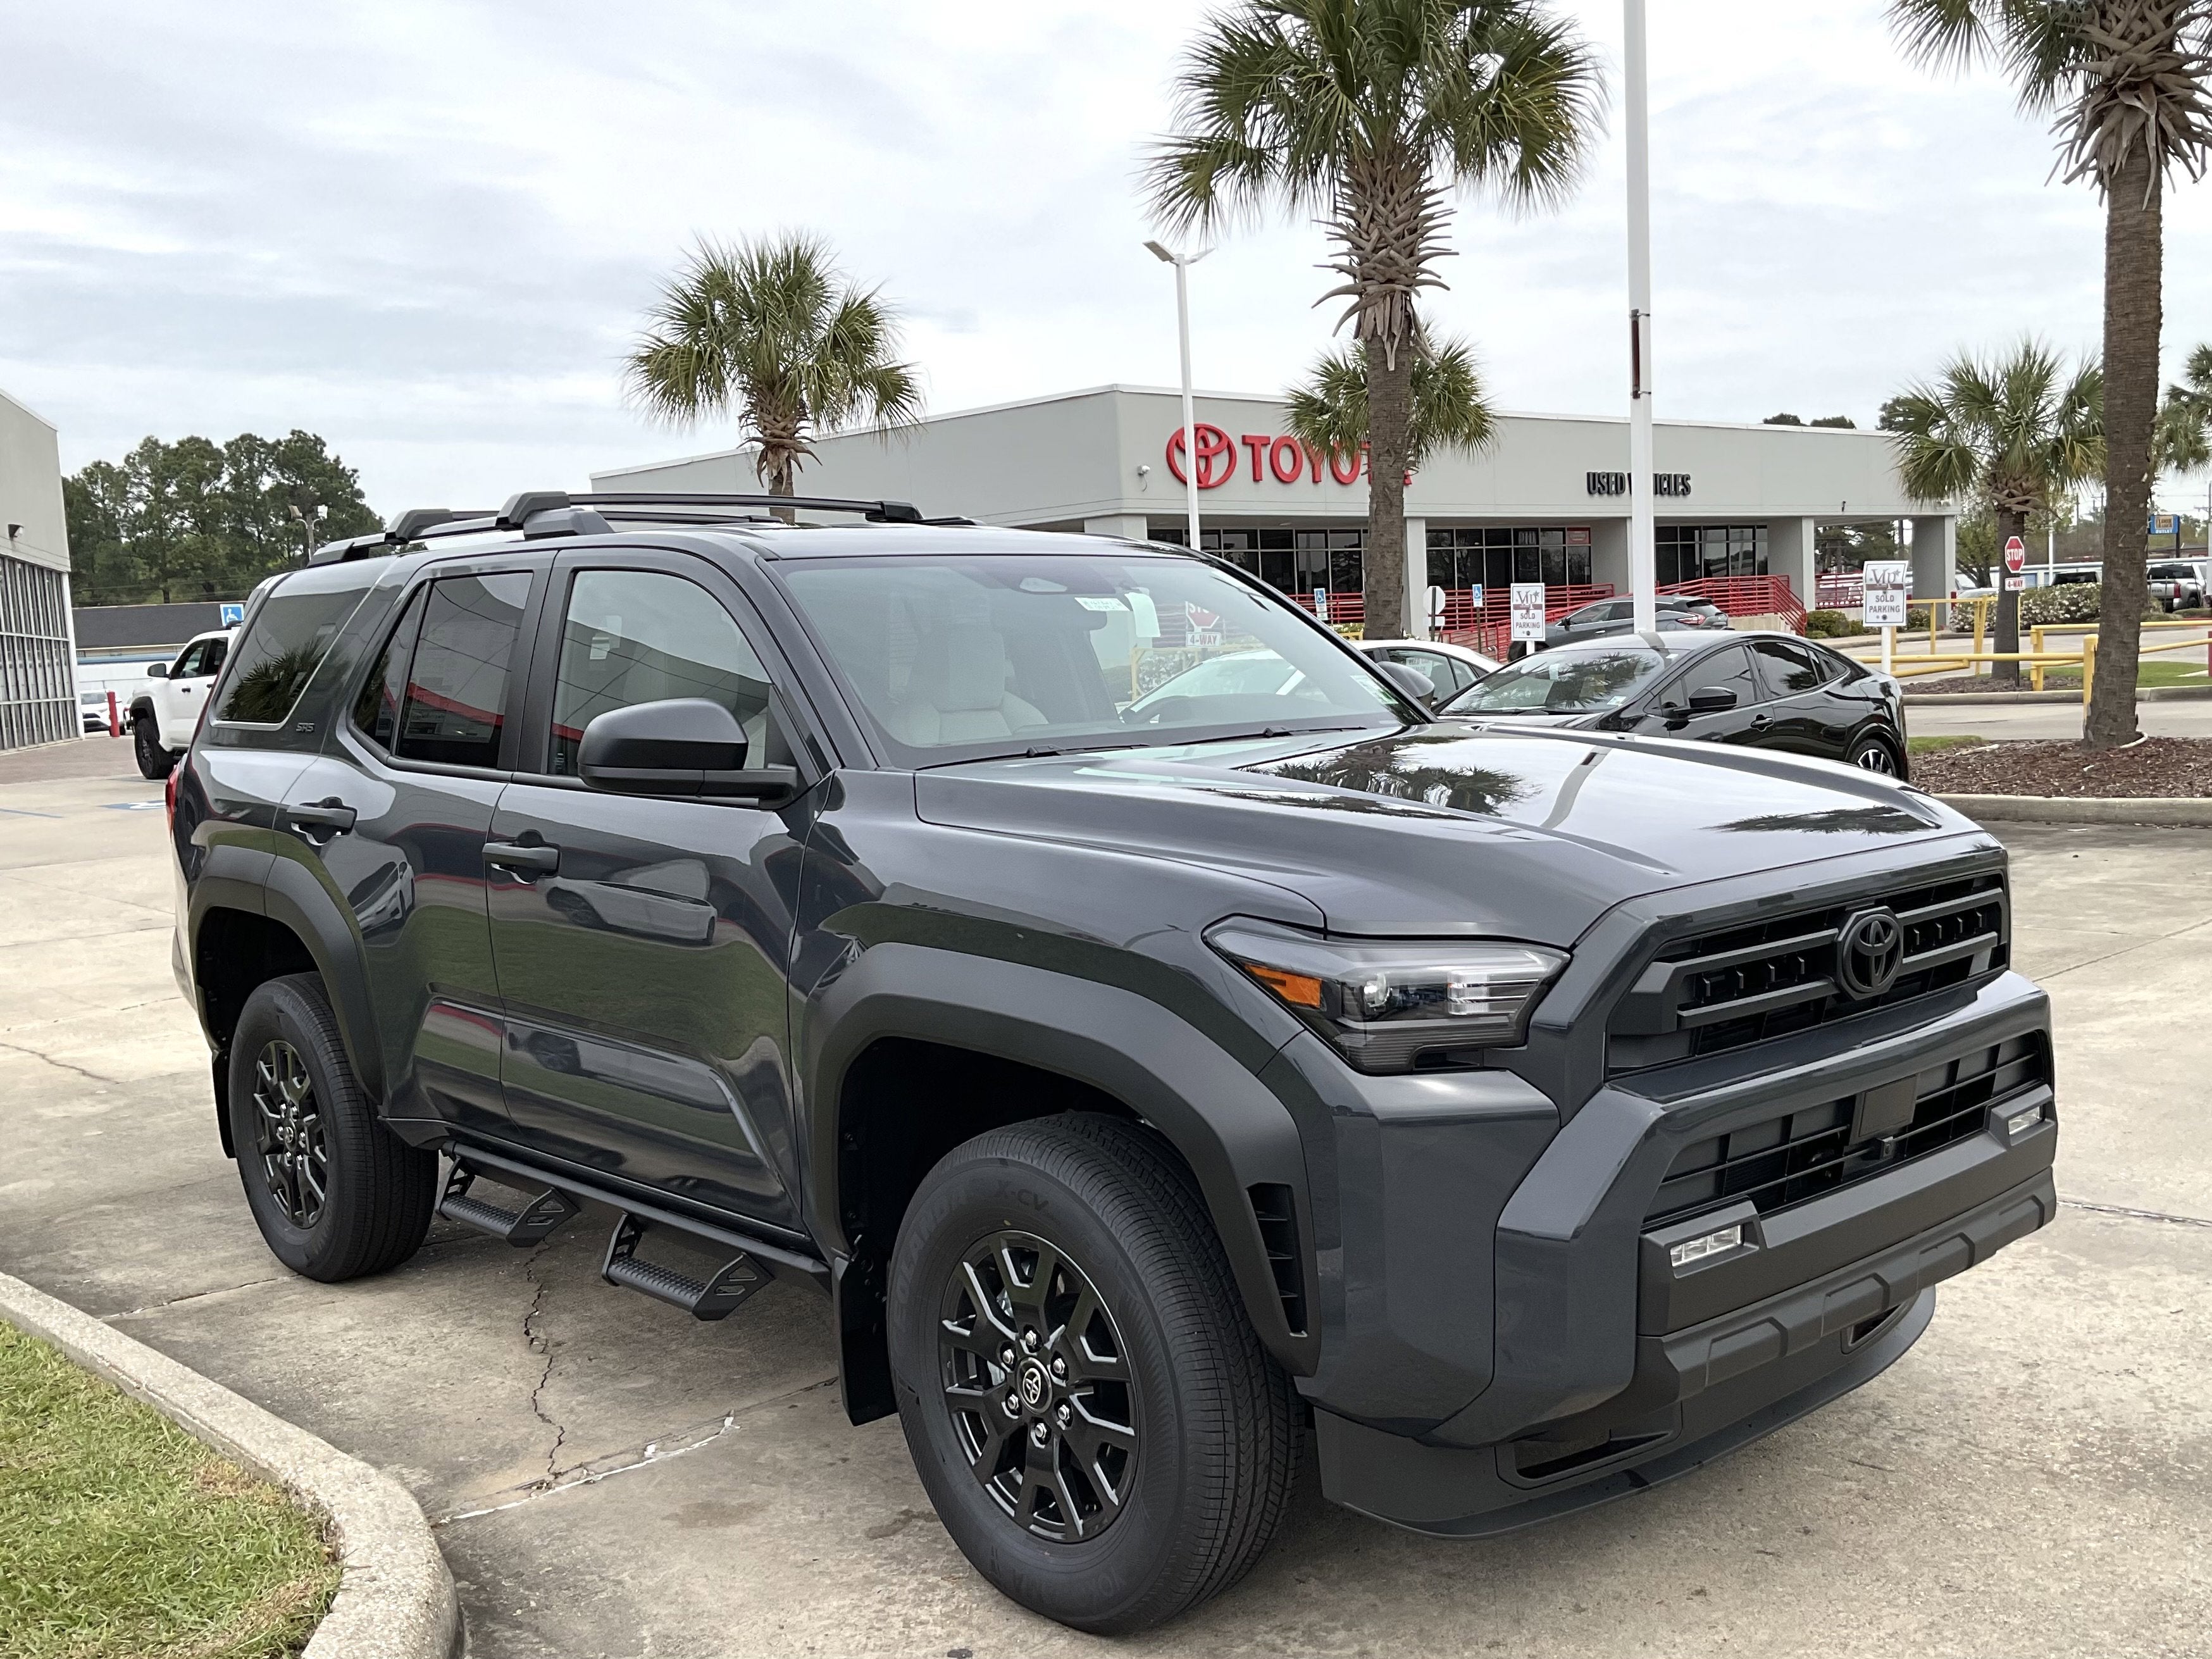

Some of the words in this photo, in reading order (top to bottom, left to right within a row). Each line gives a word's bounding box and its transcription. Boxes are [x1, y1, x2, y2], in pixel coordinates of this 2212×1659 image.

[1241, 434, 1412, 486] TOYO
[1586, 471, 1626, 495] USED
[1627, 472, 1691, 496] ICLES
[2006, 548, 2023, 561] STOP
[2007, 580, 2023, 588] 4-WAY
[1868, 605, 1901, 613] PARKING
[1190, 634, 1217, 645] 4-WAY
